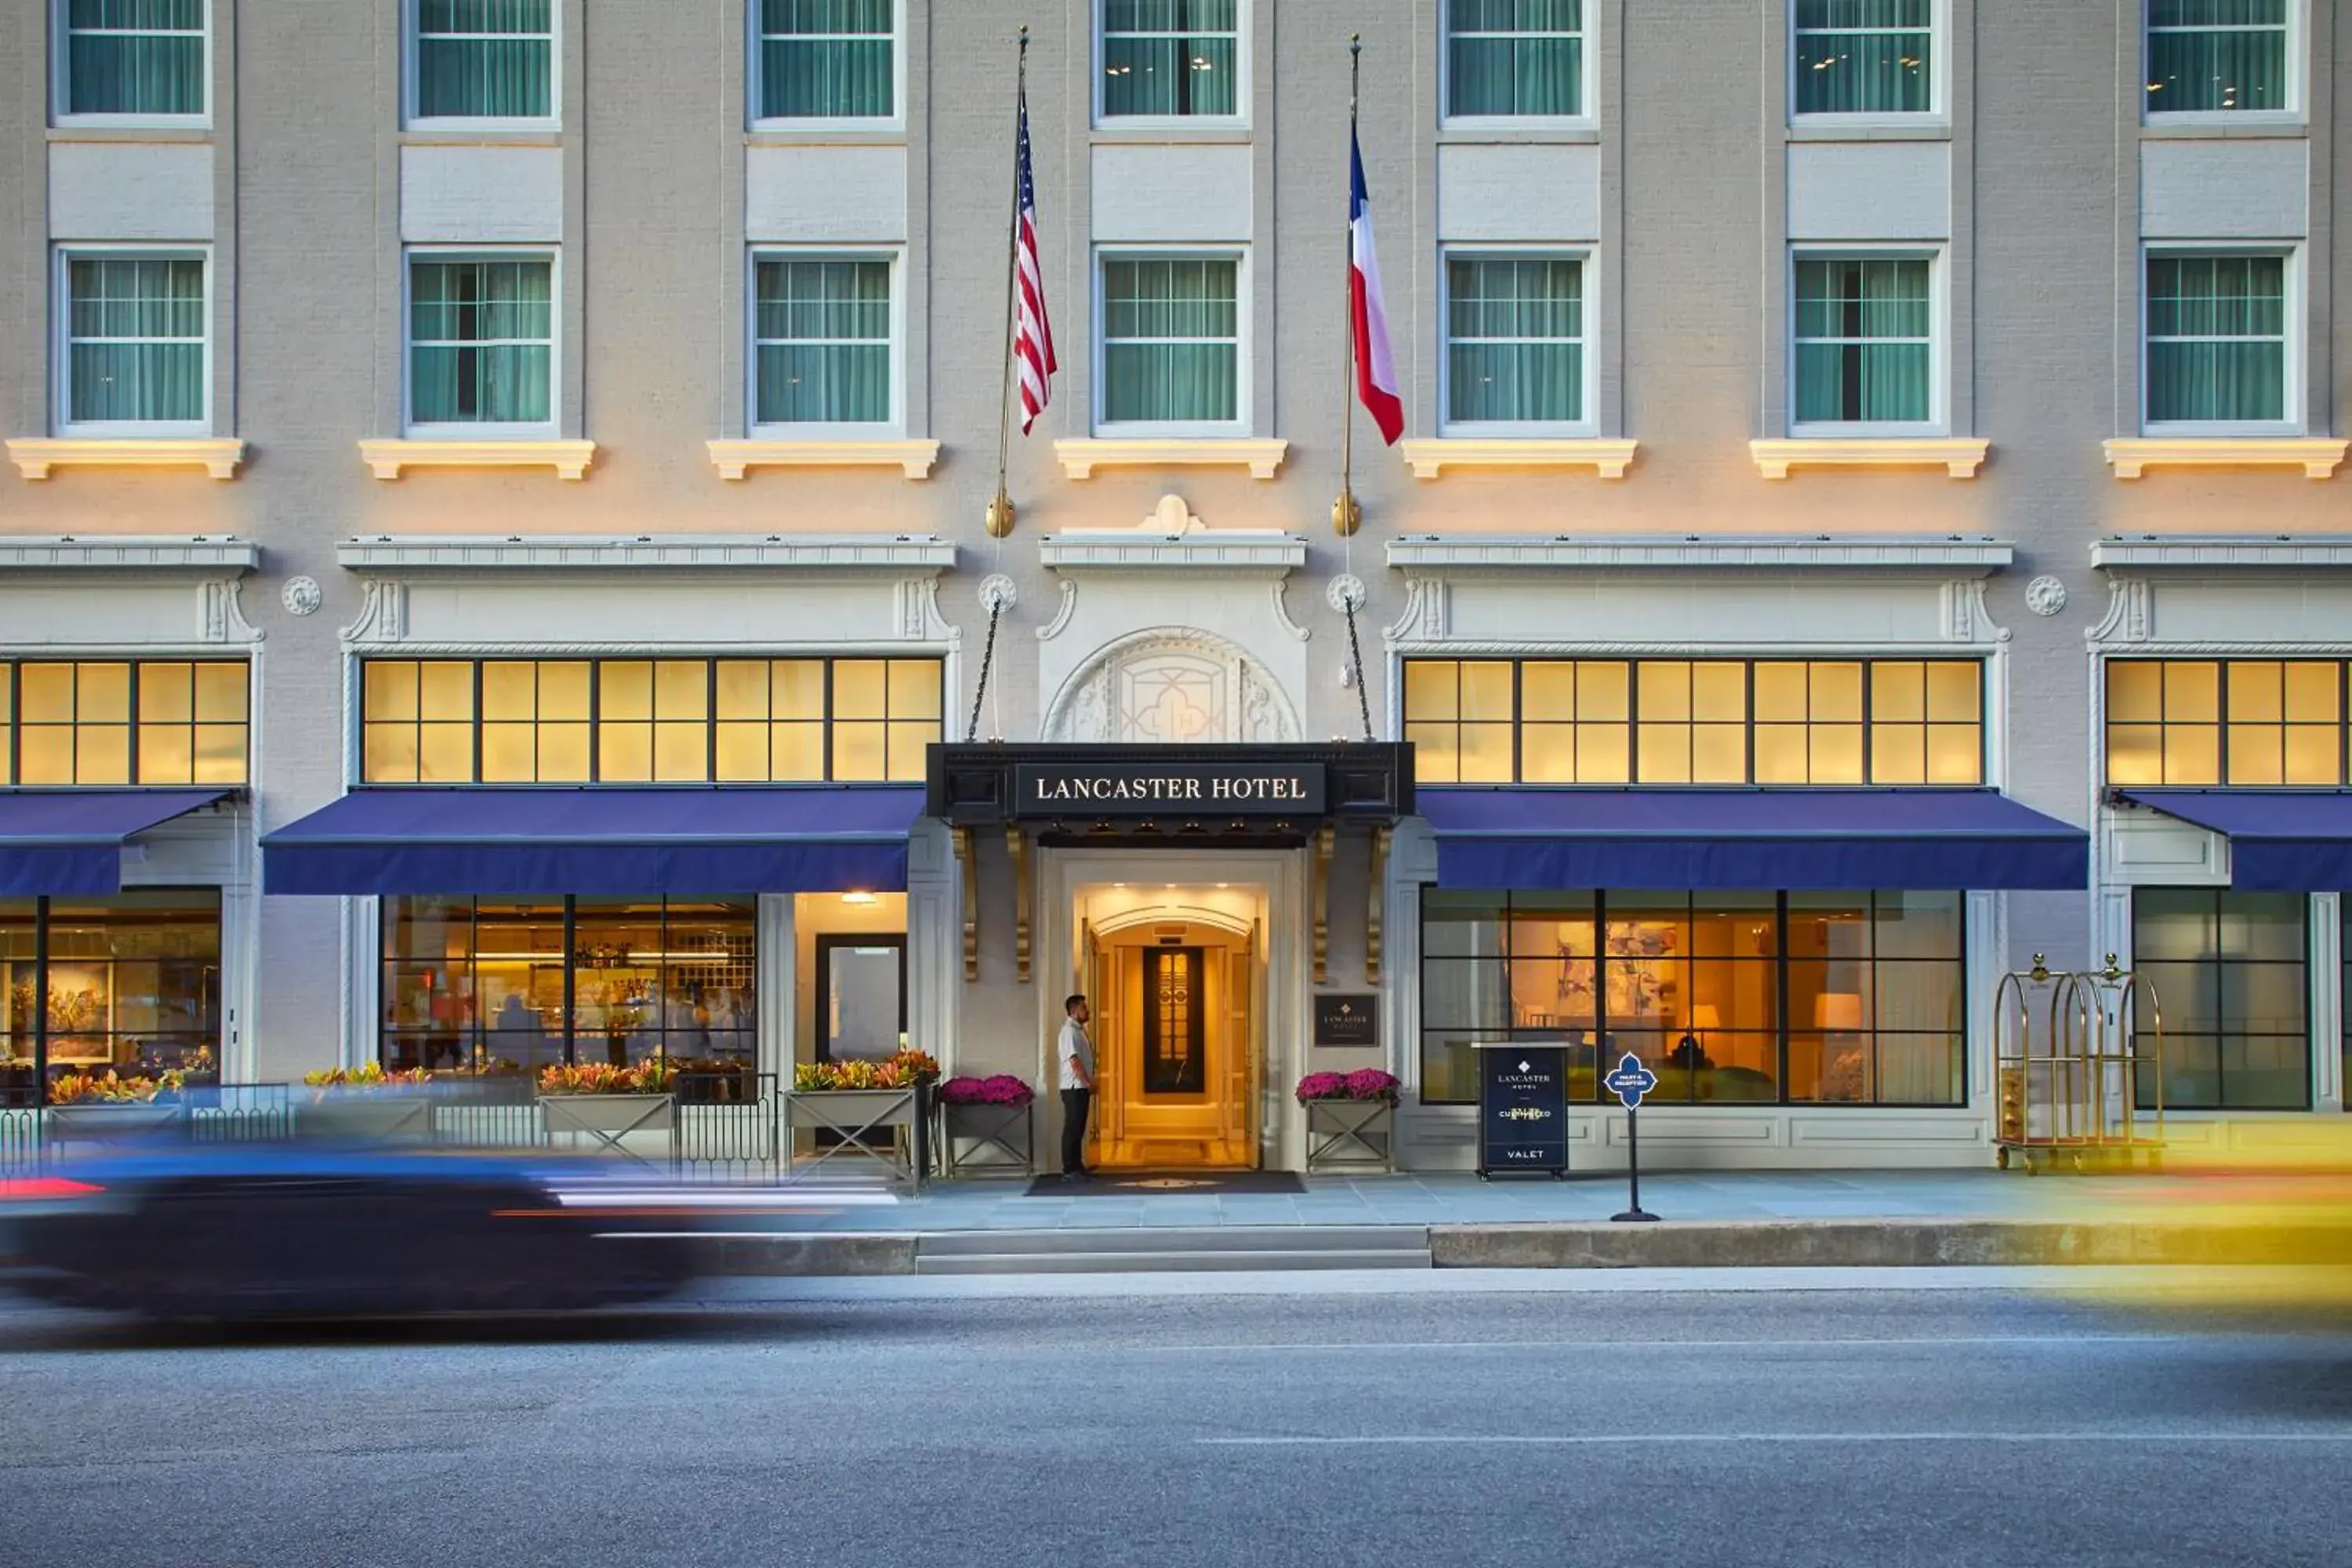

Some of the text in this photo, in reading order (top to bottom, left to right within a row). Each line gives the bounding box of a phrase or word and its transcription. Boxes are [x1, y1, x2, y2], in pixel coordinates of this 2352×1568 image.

[1036, 778, 1306, 799] LANCASTER HOTEL
[1507, 1150, 1544, 1159] VALET
